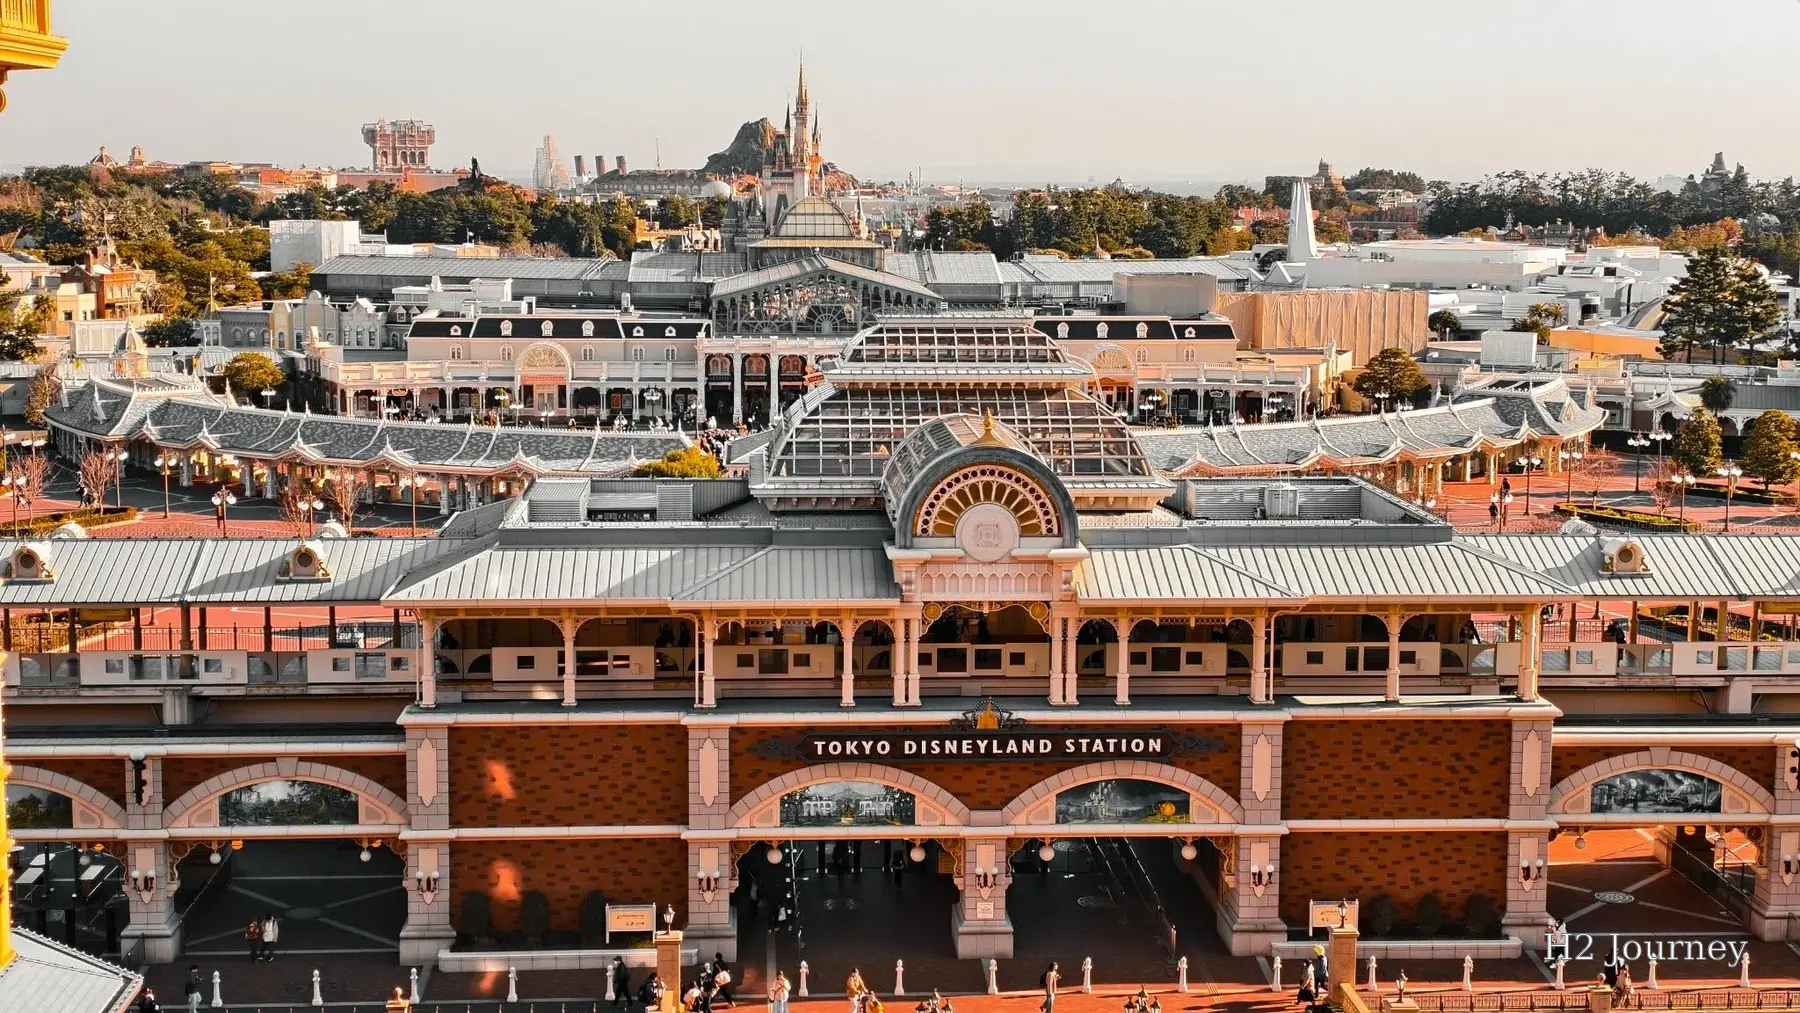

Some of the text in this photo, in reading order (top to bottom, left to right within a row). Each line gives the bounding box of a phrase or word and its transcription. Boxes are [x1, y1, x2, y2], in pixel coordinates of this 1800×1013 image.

[813, 738, 1163, 756] TOKYO DISNEYLAND STATION
